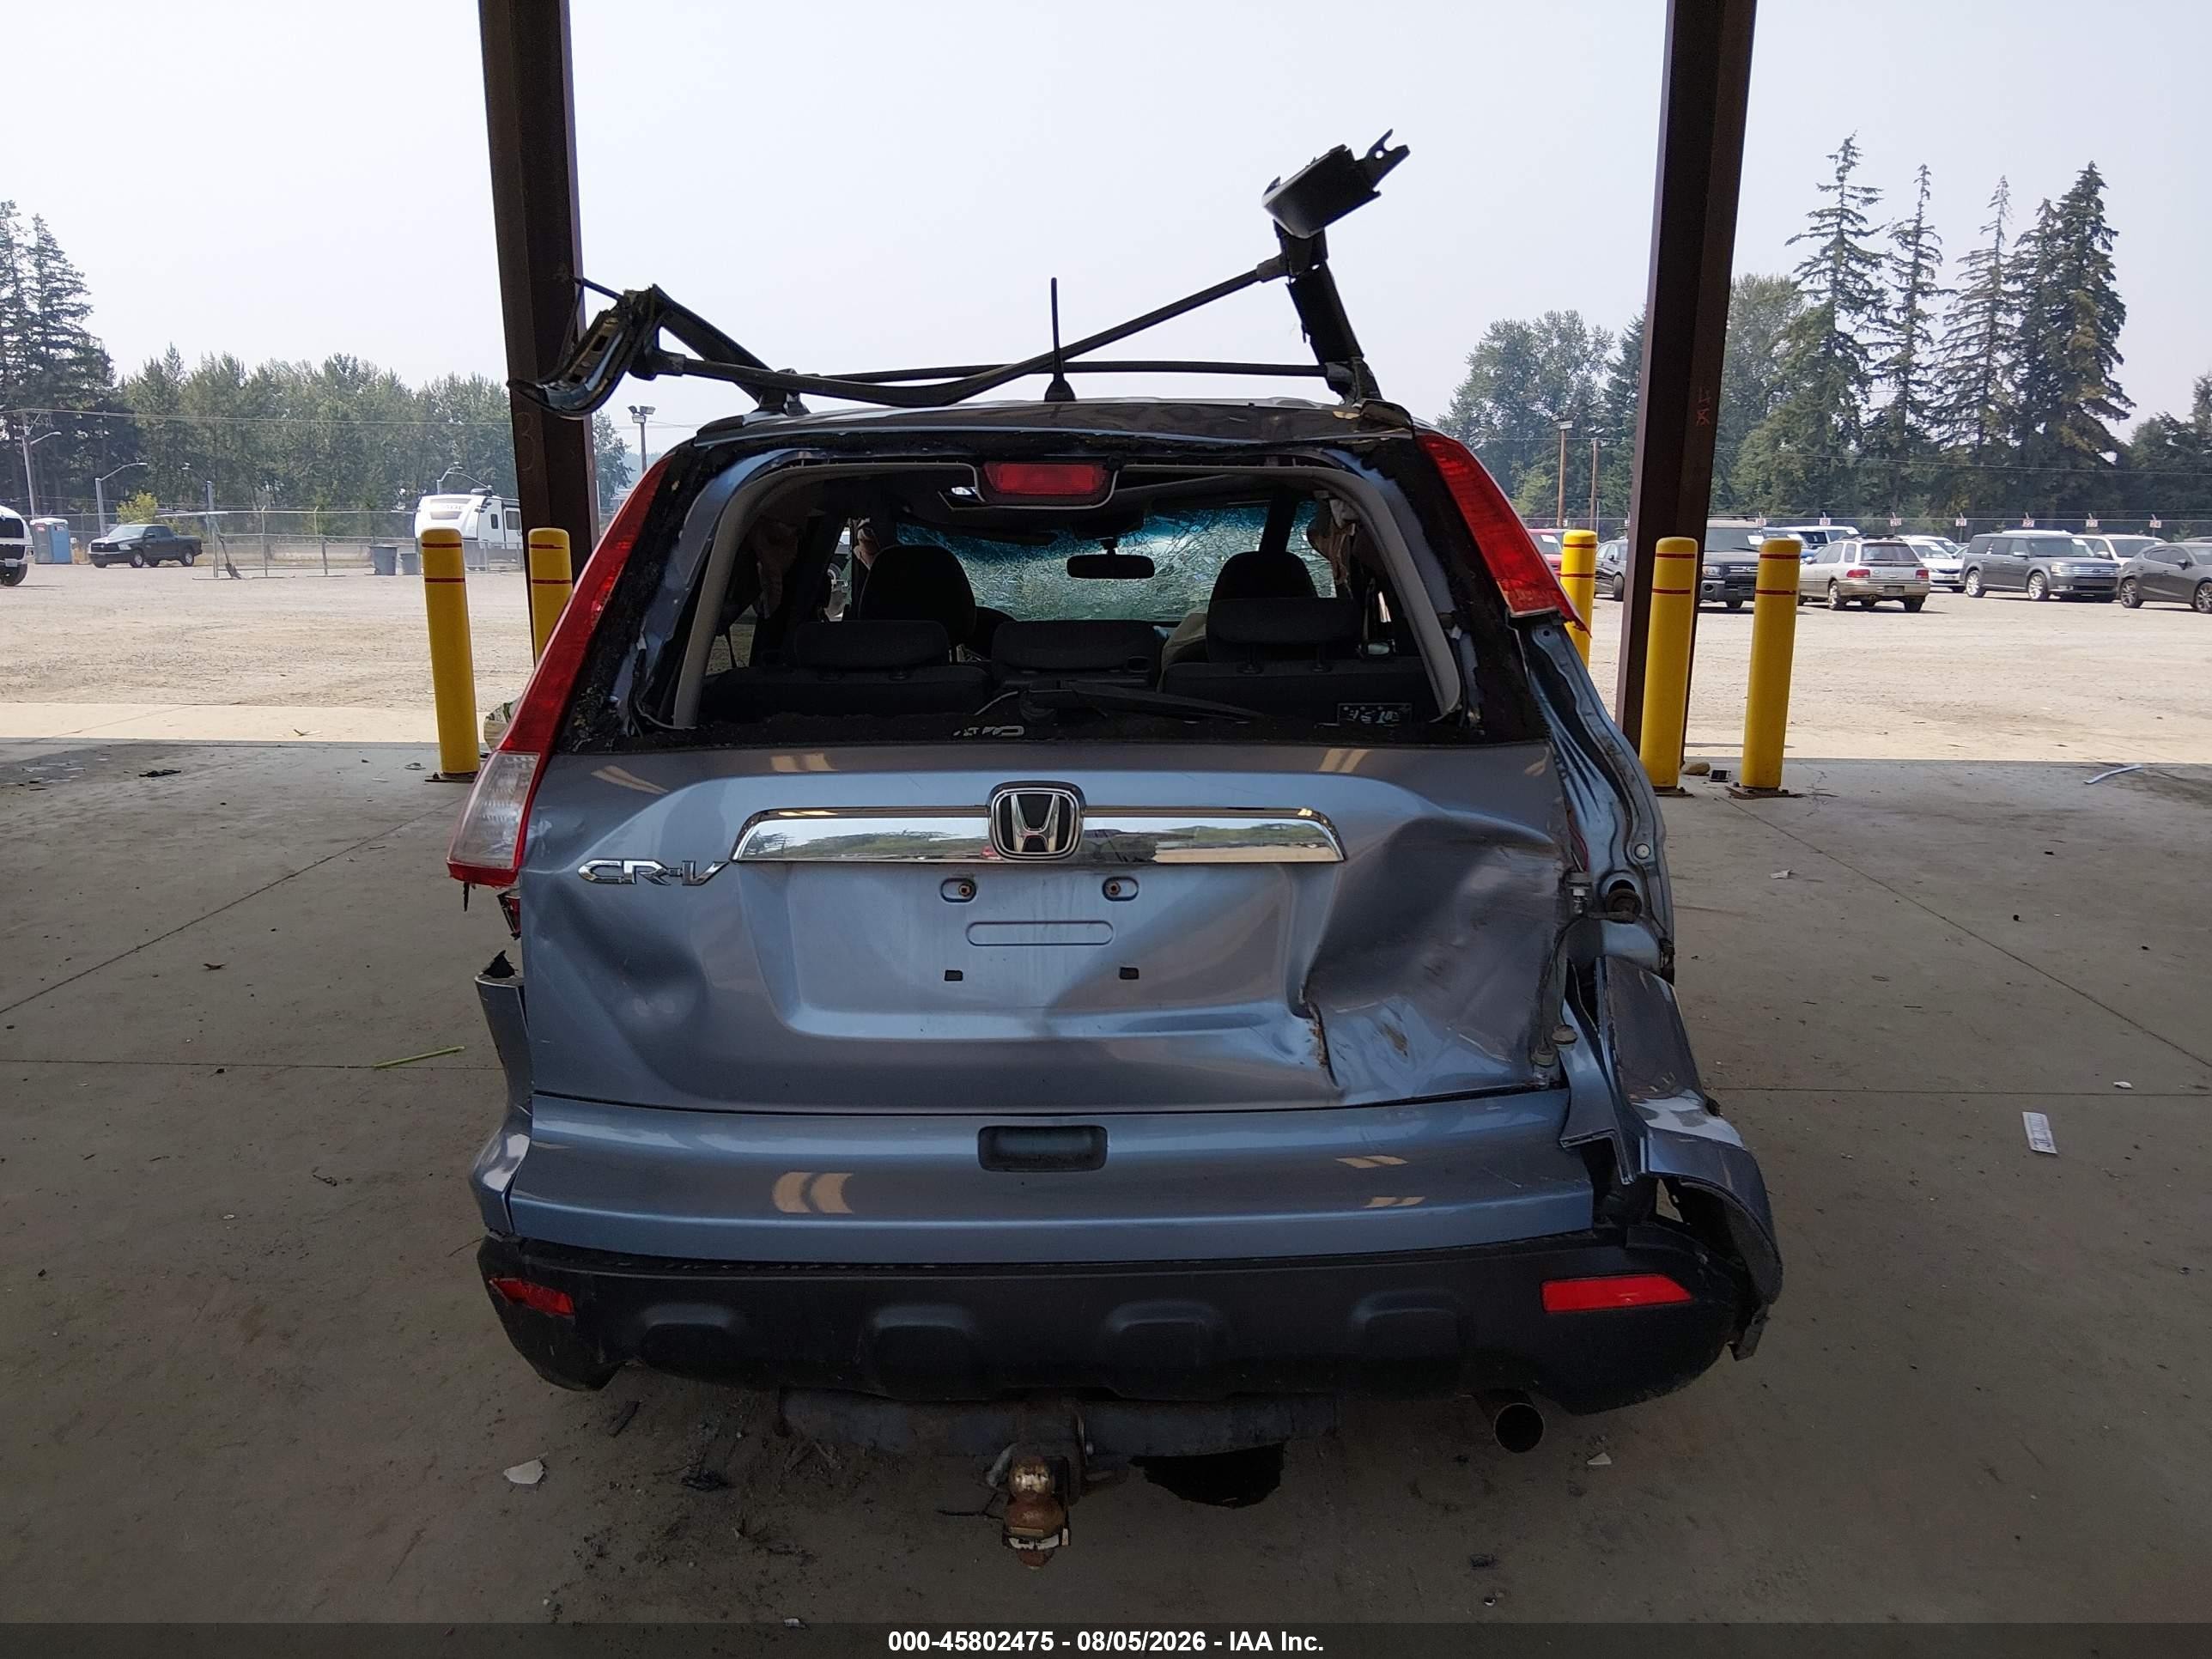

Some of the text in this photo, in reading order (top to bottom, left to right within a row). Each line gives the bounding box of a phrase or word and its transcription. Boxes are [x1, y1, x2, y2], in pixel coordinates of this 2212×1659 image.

[1891, 518, 1901, 527] 20
[2023, 520, 2033, 528] 22
[577, 859, 730, 886] CR-V
